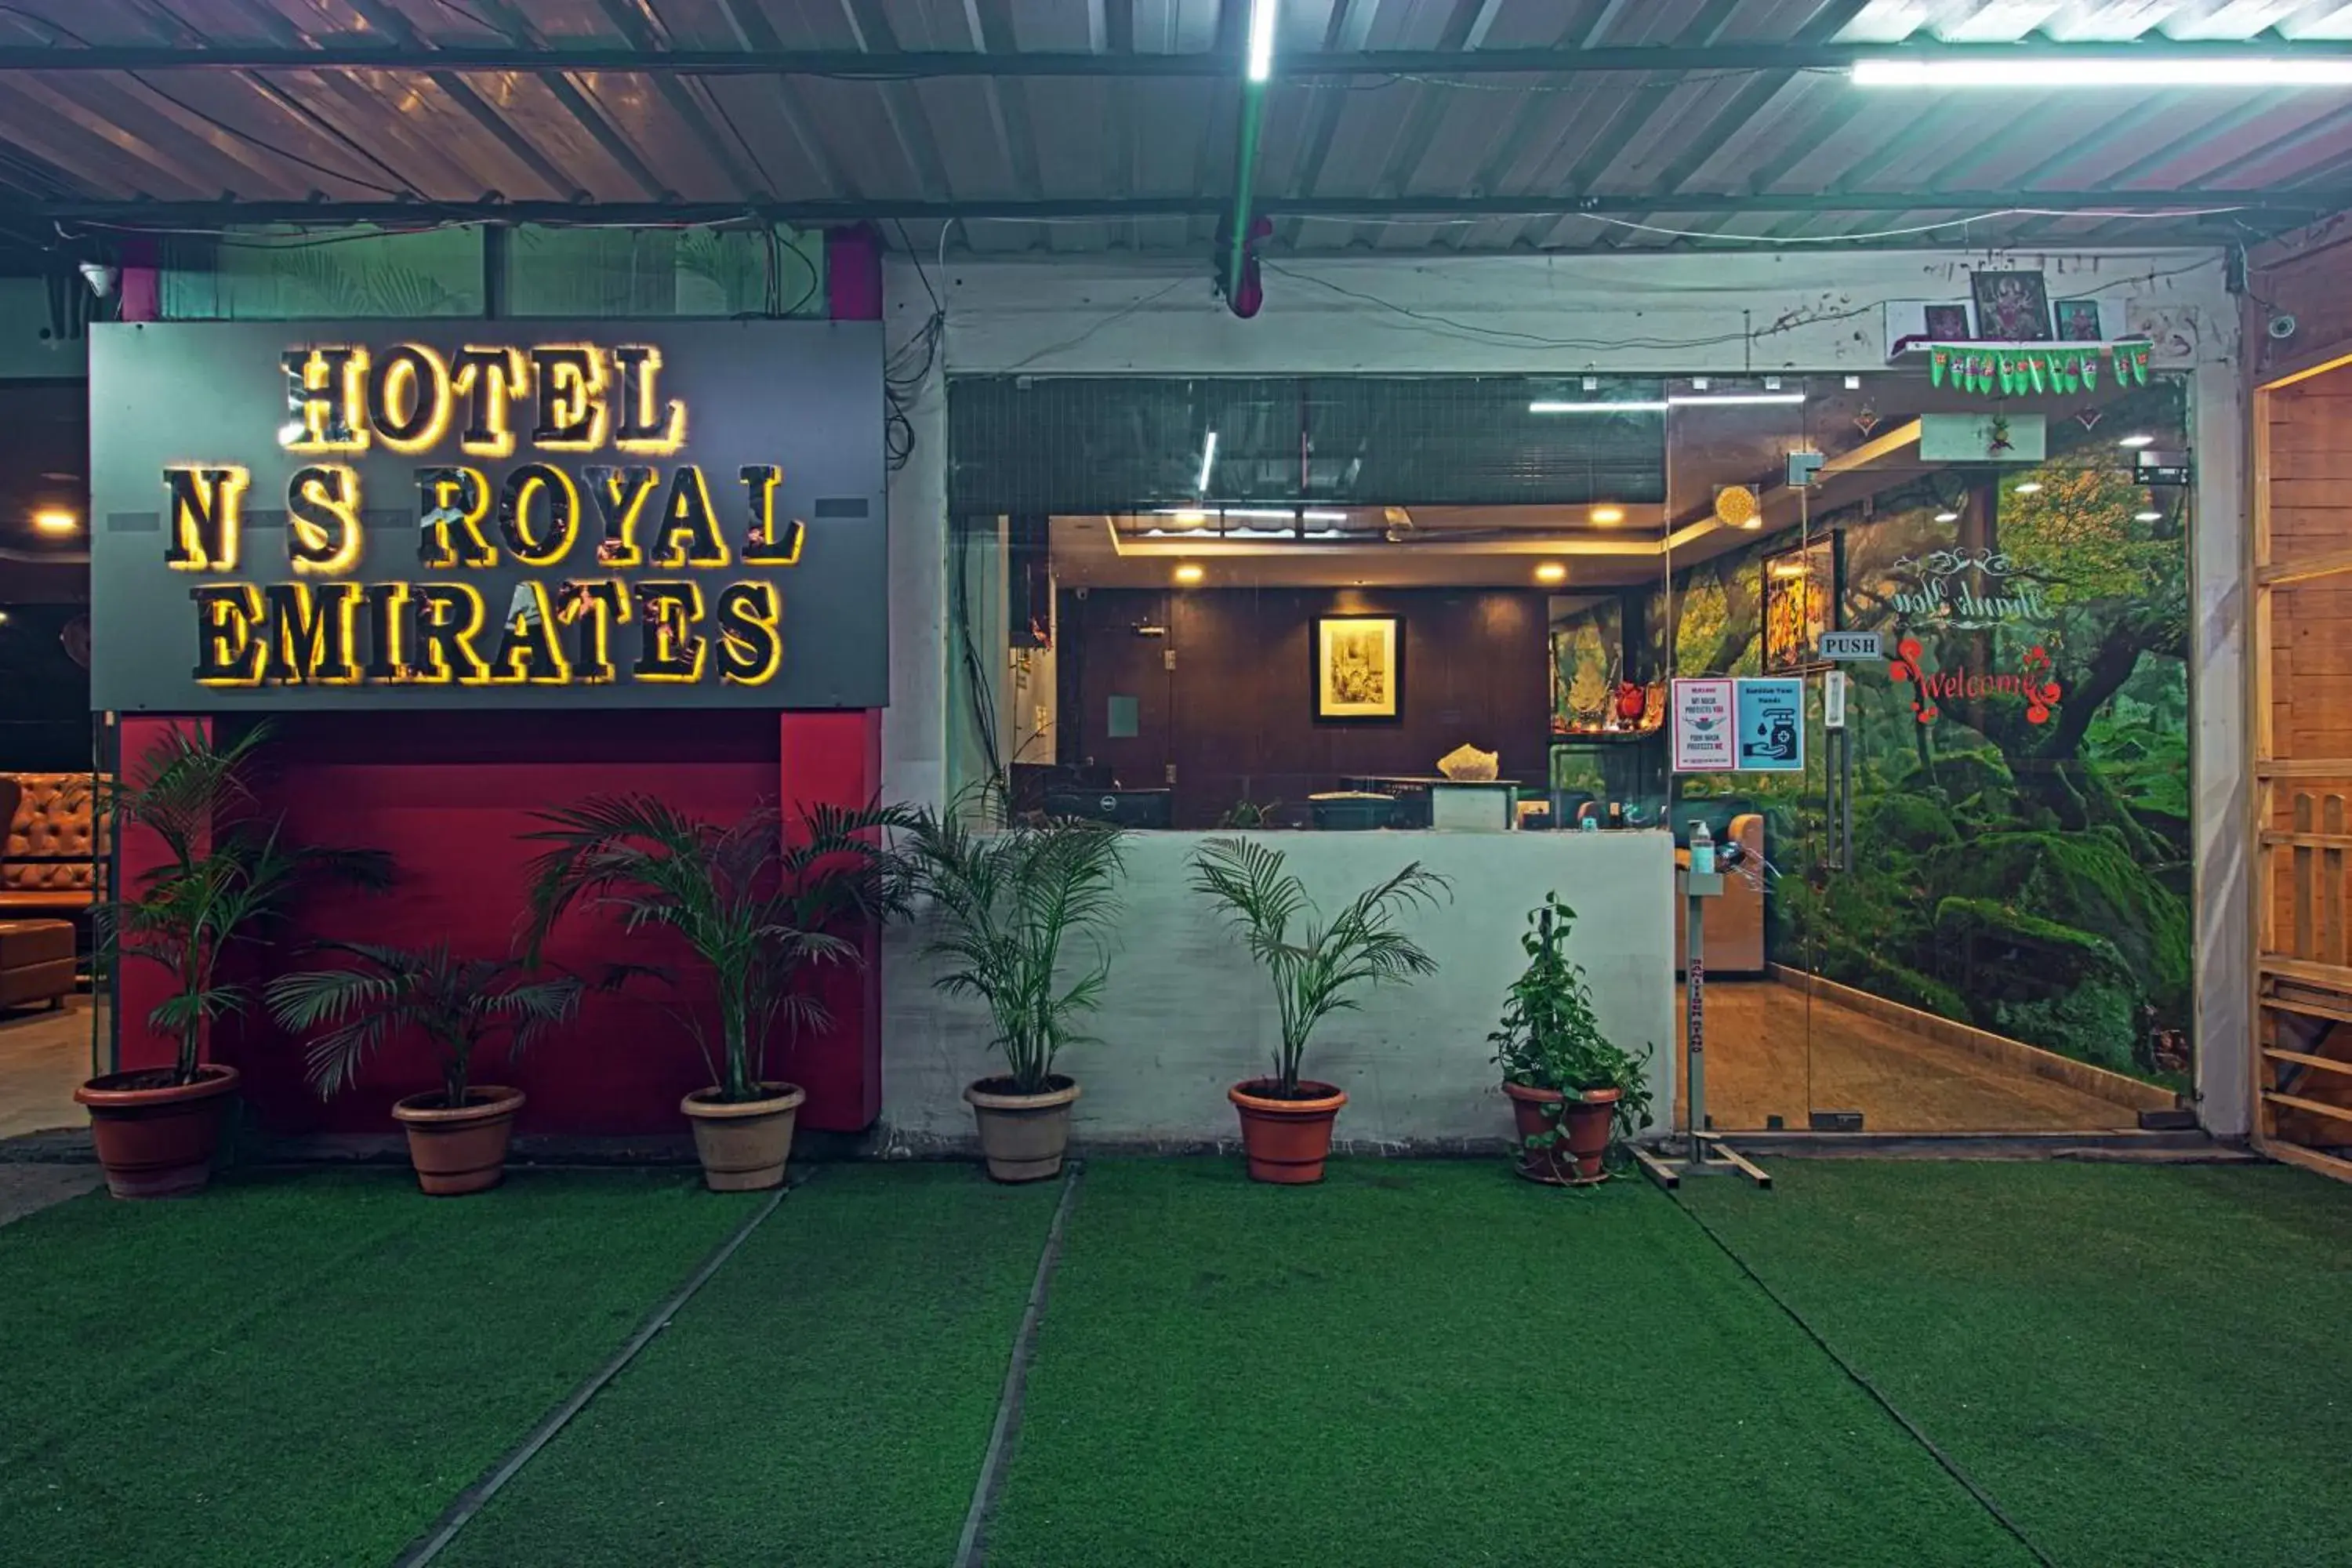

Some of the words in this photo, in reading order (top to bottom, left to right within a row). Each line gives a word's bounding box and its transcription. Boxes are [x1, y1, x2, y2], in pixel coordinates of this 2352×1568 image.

[281, 343, 685, 455] HOTEL
[163, 465, 249, 568] N
[288, 465, 361, 573] S
[417, 462, 805, 567] ROYAL
[191, 579, 784, 687] EMIRATES
[1825, 639, 1876, 653] PUSH
[1920, 665, 2037, 699] Welcome
